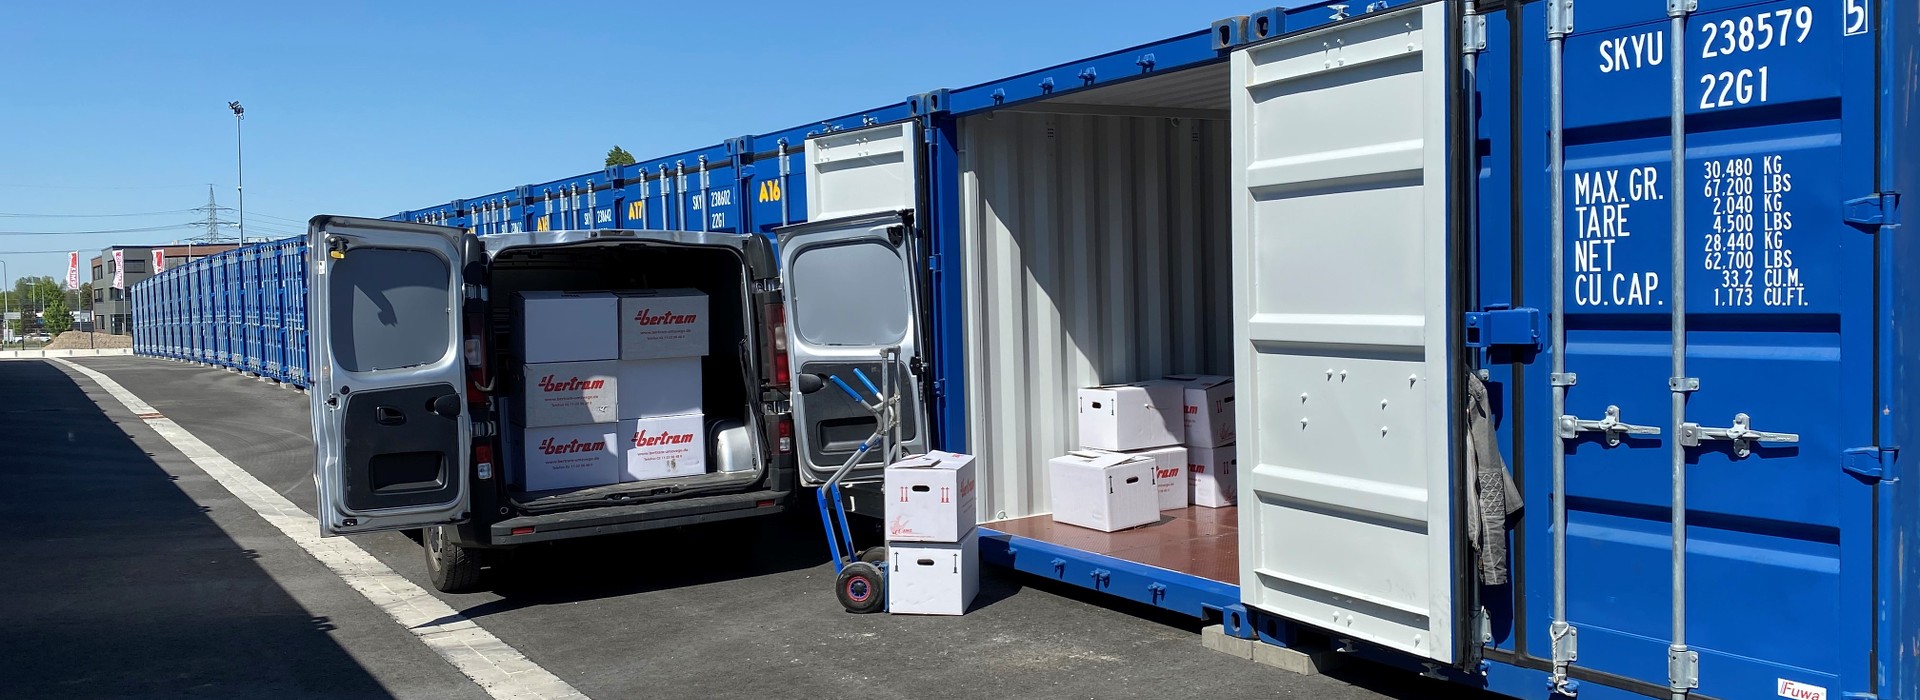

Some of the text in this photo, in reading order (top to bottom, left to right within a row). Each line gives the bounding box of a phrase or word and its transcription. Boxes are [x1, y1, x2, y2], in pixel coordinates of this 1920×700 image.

[1600, 0, 1865, 72] SKYU 238579 5
[1700, 66, 1767, 109] 22G1
[1764, 155, 1782, 174] KG
[759, 179, 781, 203] A16
[1764, 174, 1791, 193] LBS
[711, 190, 731, 208] 238602
[1764, 193, 1782, 212] KG
[628, 201, 643, 220] A17
[711, 212, 725, 229] 22G1
[1575, 204, 1630, 238] TARE
[1764, 212, 1792, 231] LBS
[1765, 231, 1783, 250] KG
[1575, 239, 1615, 272] NET
[1765, 250, 1792, 269] LBS
[1722, 268, 1803, 288] 33.2 CU.M.
[1575, 272, 1663, 306] CU.CAP.
[1764, 287, 1808, 307] CU.FT.
[639, 308, 697, 326] bertram
[544, 374, 605, 392] bertram
[544, 436, 605, 455] bertram
[636, 429, 694, 447] bertram
[1782, 682, 1820, 700] Fuwa
